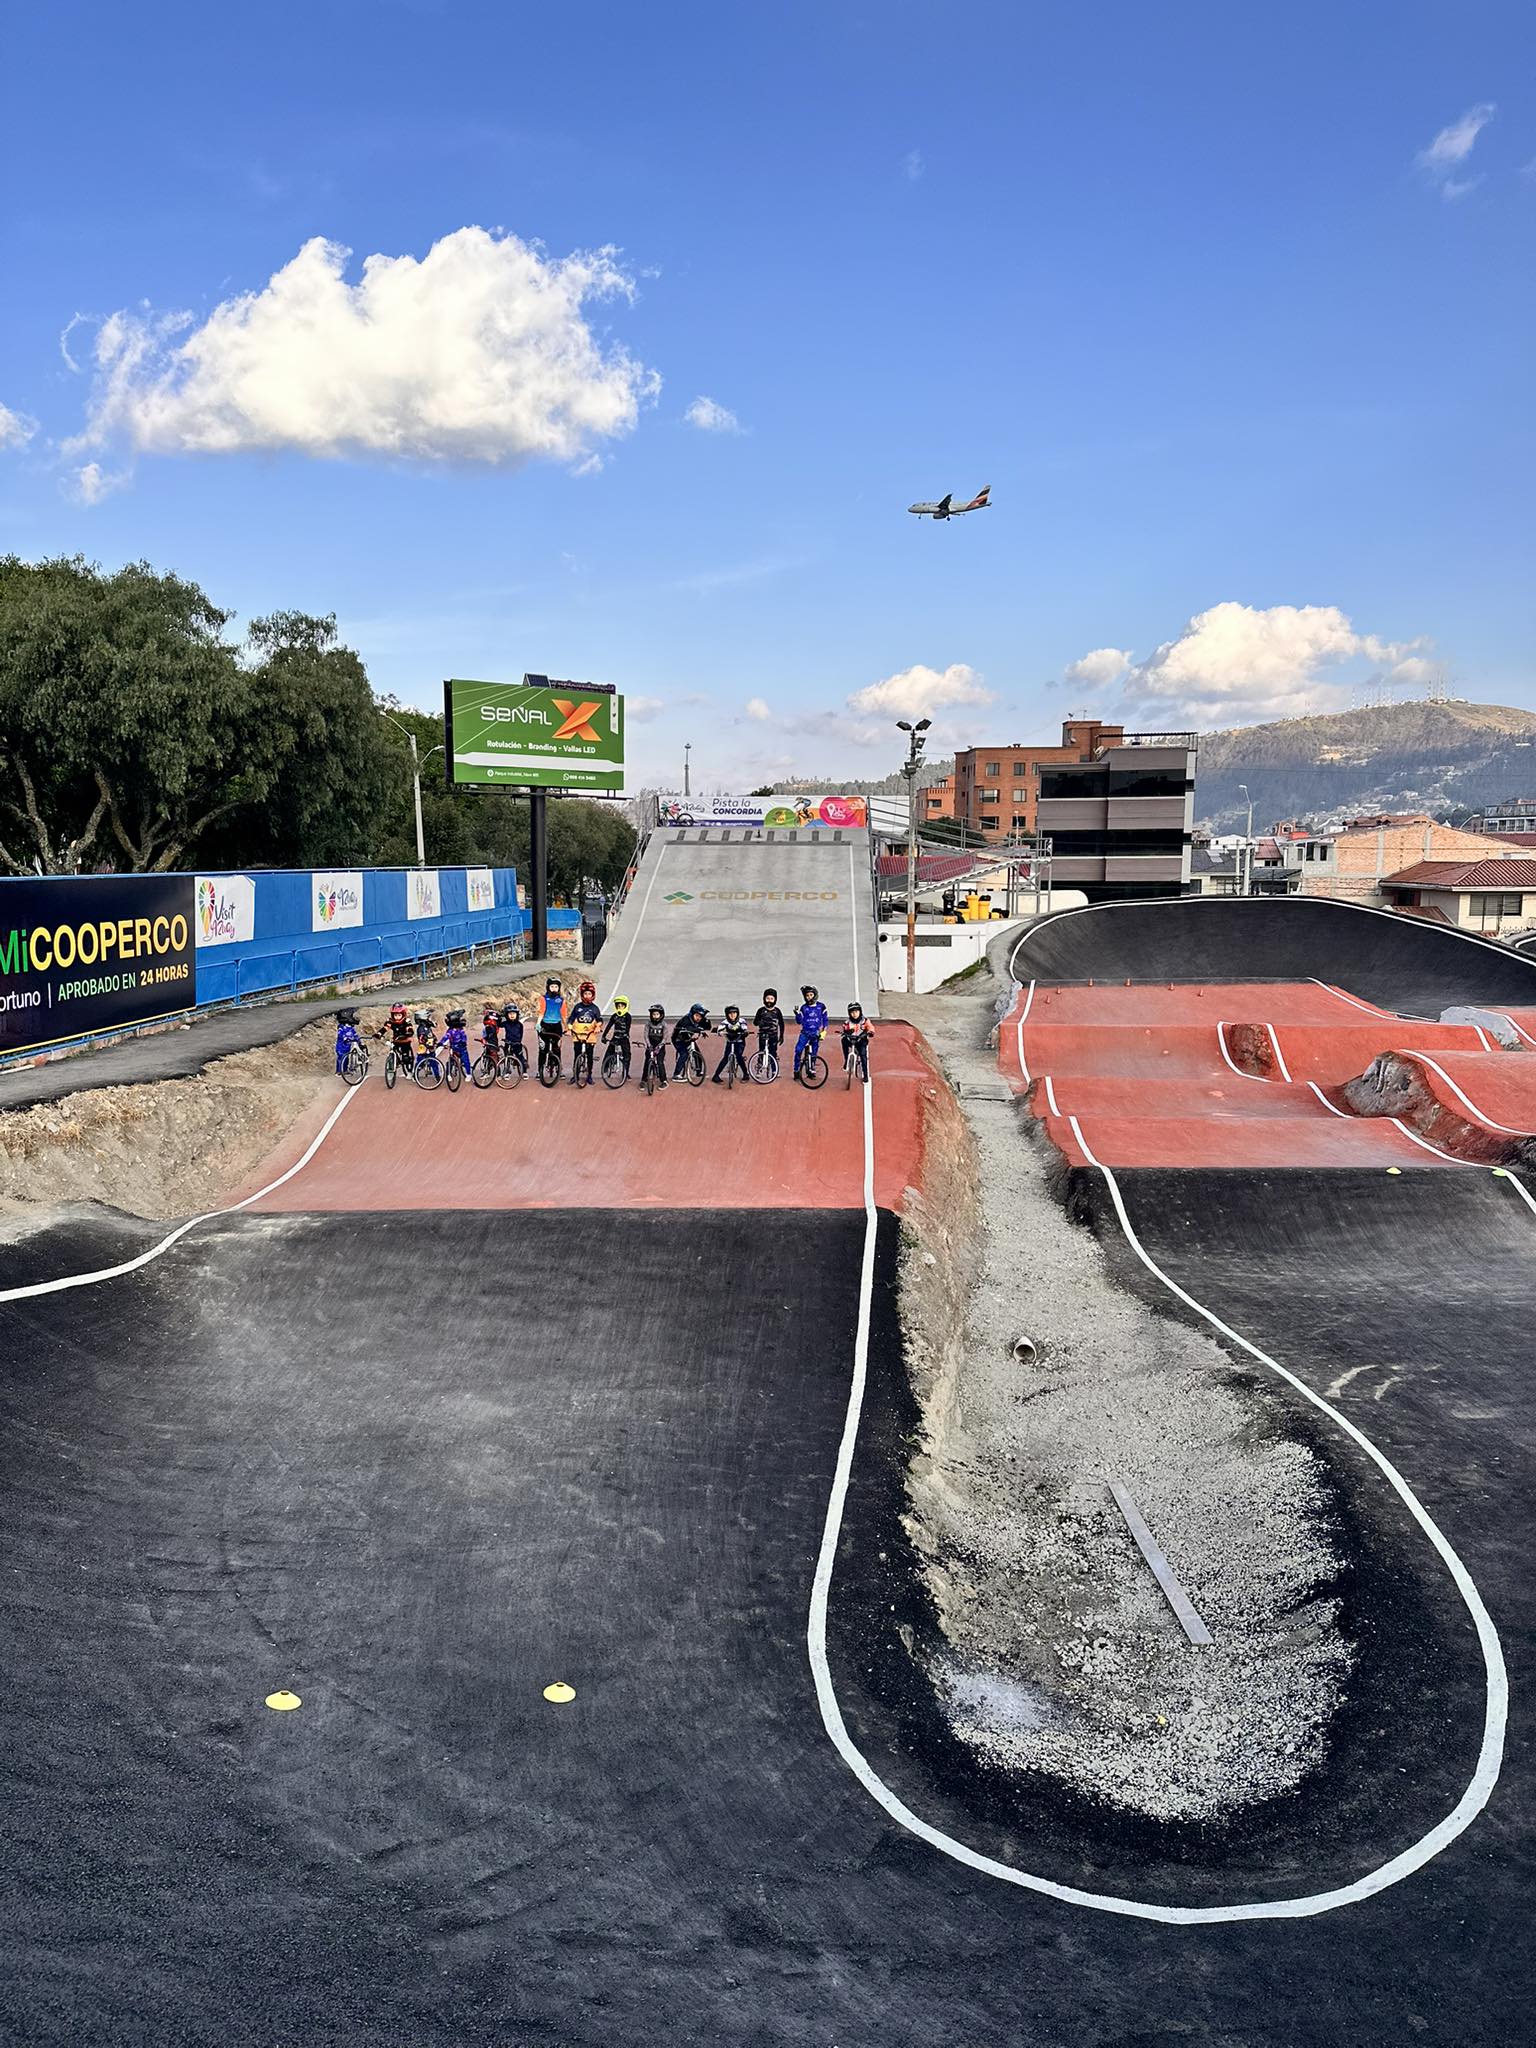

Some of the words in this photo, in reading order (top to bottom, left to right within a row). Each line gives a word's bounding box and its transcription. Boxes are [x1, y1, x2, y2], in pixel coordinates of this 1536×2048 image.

[486, 740, 522, 750] Rotulación
[528, 742, 557, 752] Branding
[563, 745, 582, 753] Vallas
[712, 798, 739, 808] Pista
[741, 798, 751, 807] la
[712, 808, 763, 816] CONCORDIA
[699, 891, 839, 901] COOPERCO
[215, 895, 236, 920] Visit
[58, 974, 120, 1002] APROBADO
[122, 972, 136, 989] EN
[140, 970, 154, 987] 24
[155, 963, 189, 983] HORAS
